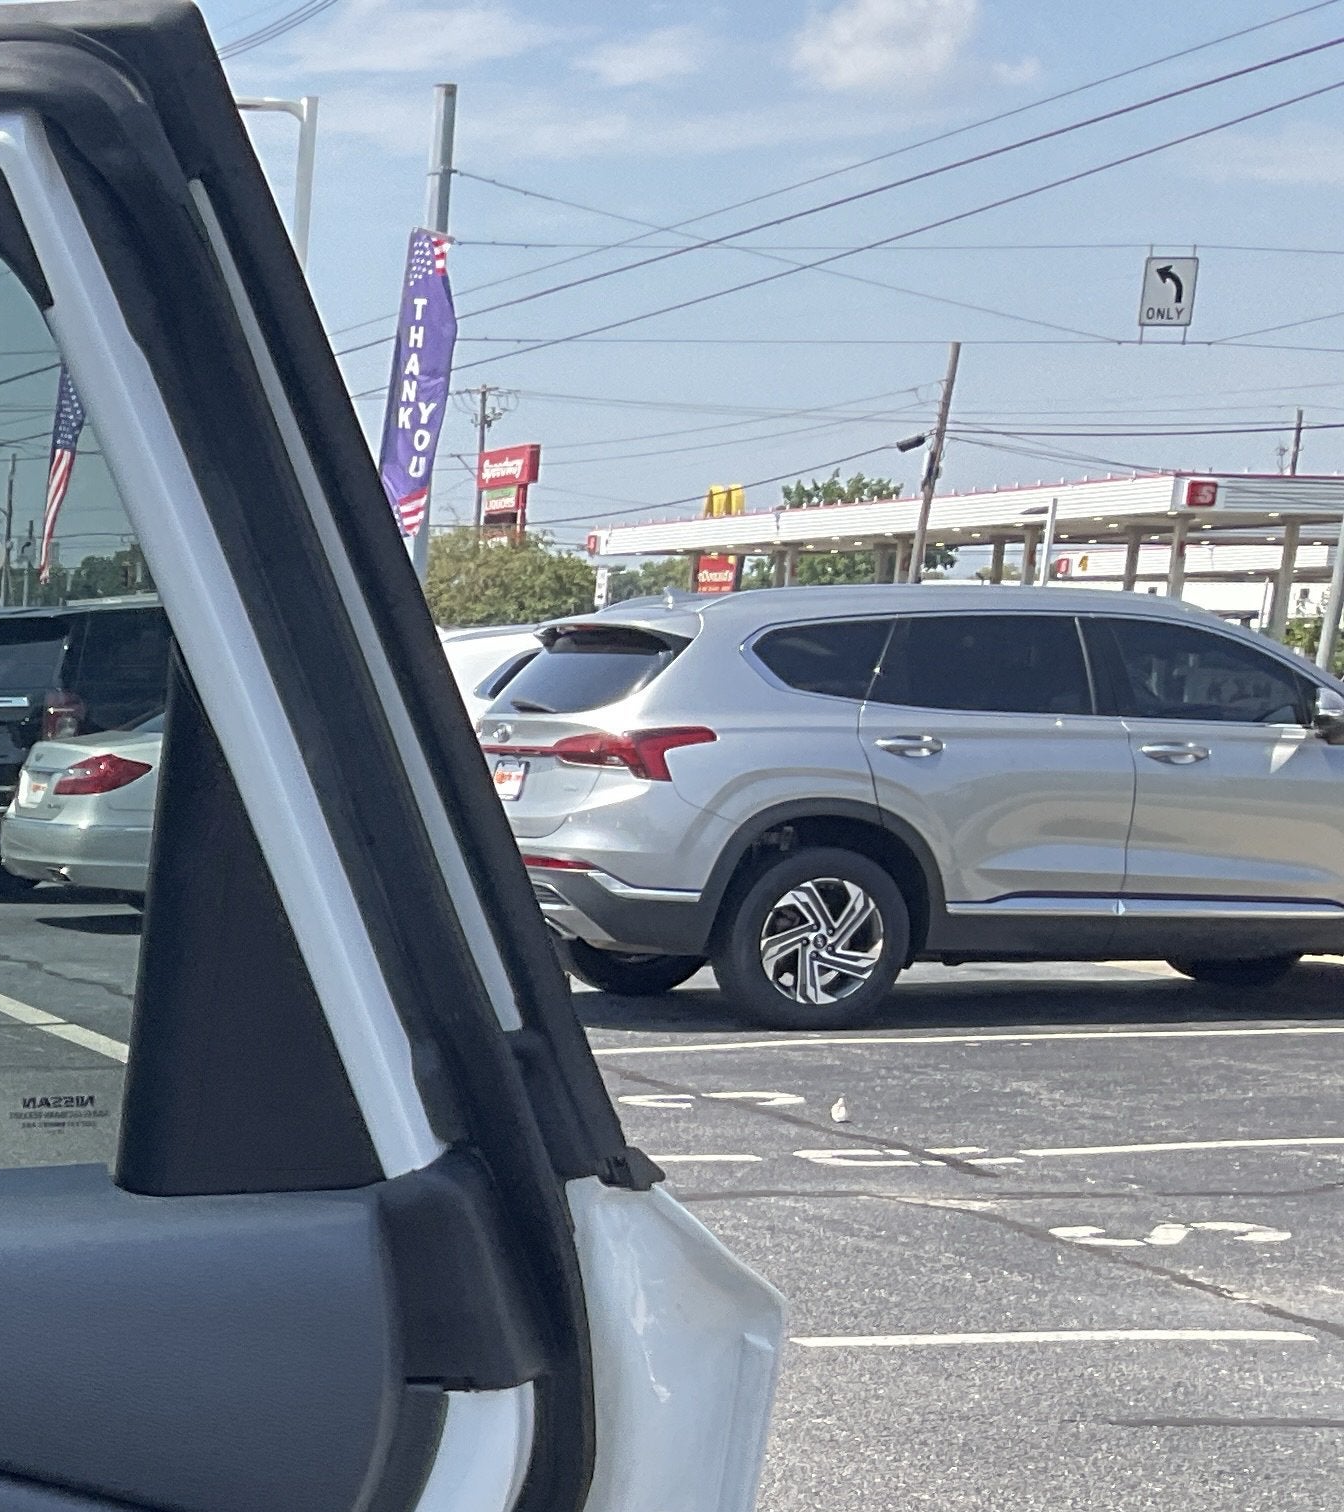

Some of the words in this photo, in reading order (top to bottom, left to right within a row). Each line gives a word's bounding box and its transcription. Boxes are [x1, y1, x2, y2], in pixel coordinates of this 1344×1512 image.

[1146, 307, 1185, 320] ONLY
[398, 298, 428, 430] THANK
[408, 402, 437, 478] YOU
[482, 456, 524, 483] Speedway
